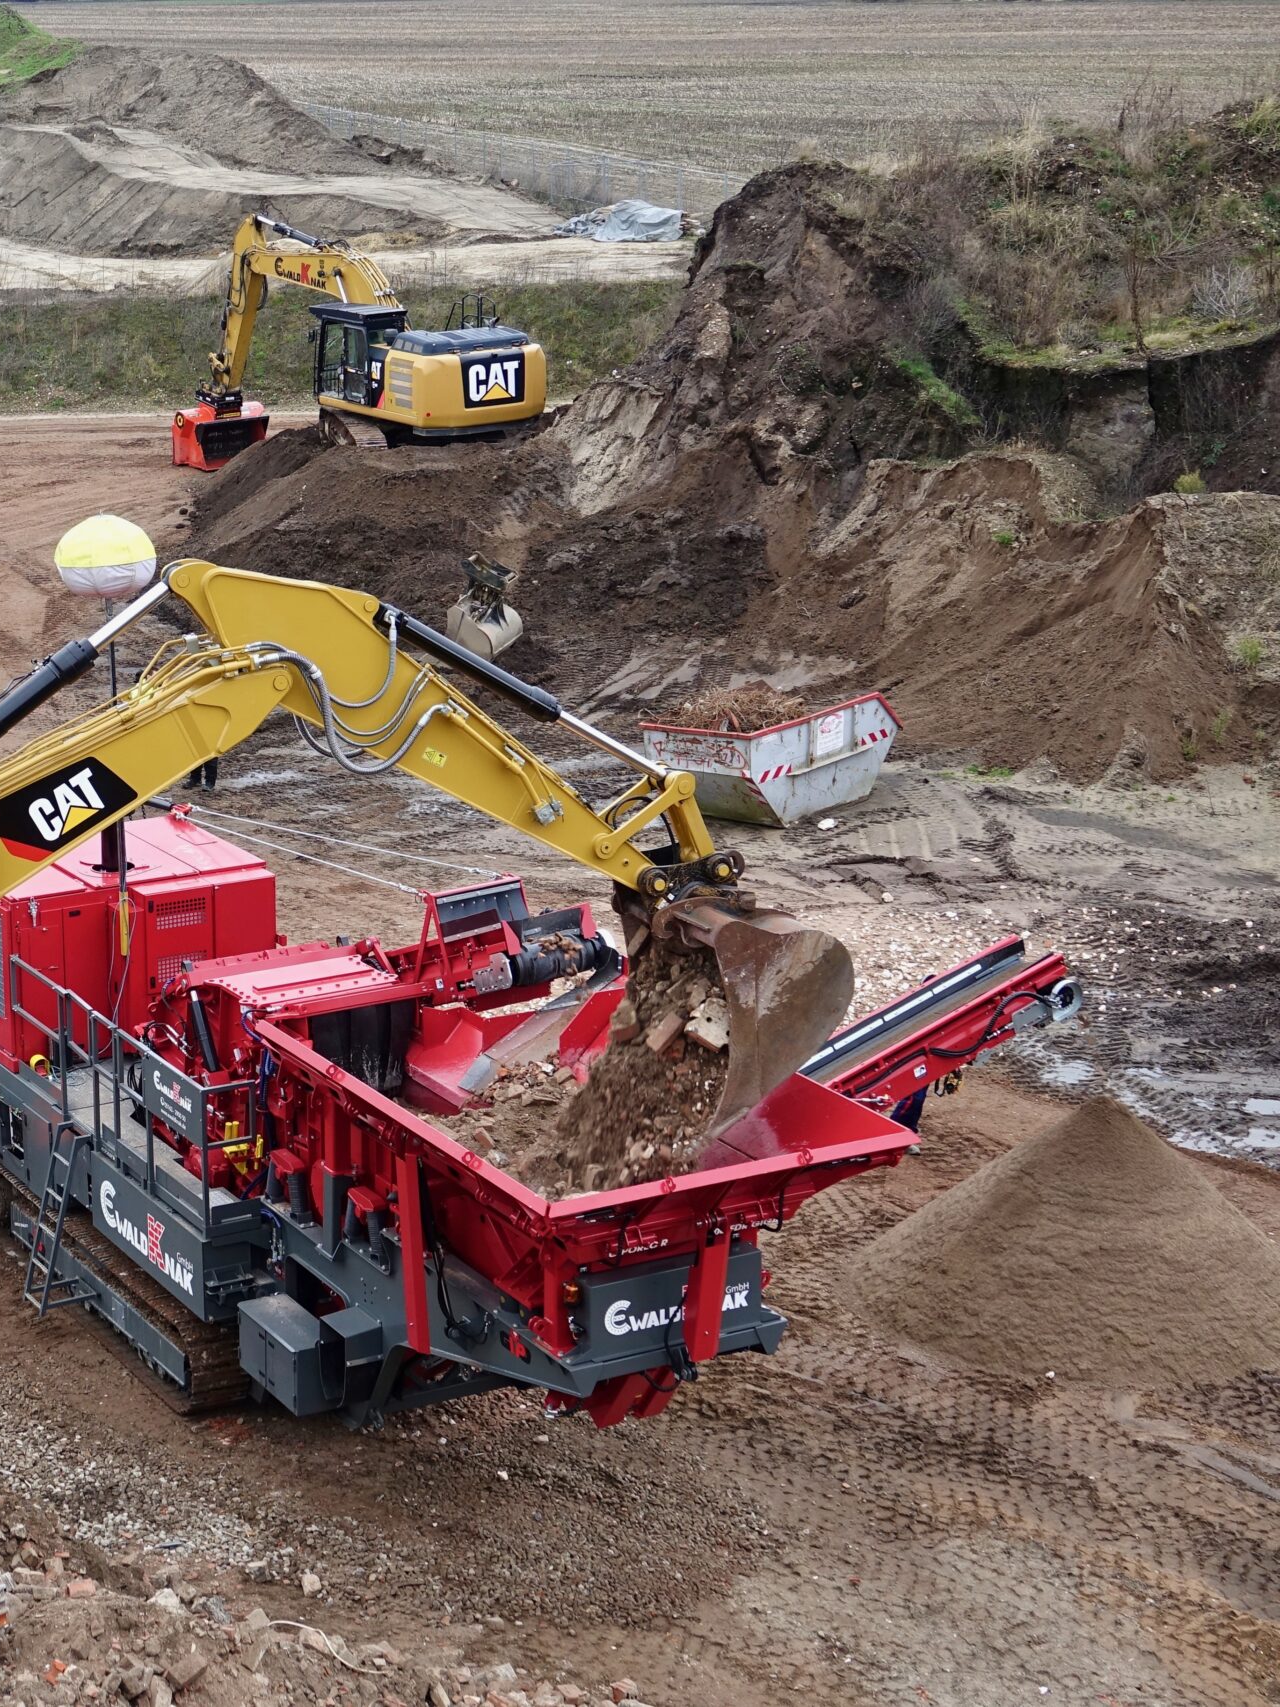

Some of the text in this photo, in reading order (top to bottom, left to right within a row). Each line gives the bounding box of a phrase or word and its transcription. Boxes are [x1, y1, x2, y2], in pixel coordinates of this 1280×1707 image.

[365, 361, 382, 380] AT
[468, 360, 521, 402] CAT
[28, 767, 105, 841] CAT
[176, 1252, 194, 1273] GmbH
[725, 1282, 750, 1294] GmbH
